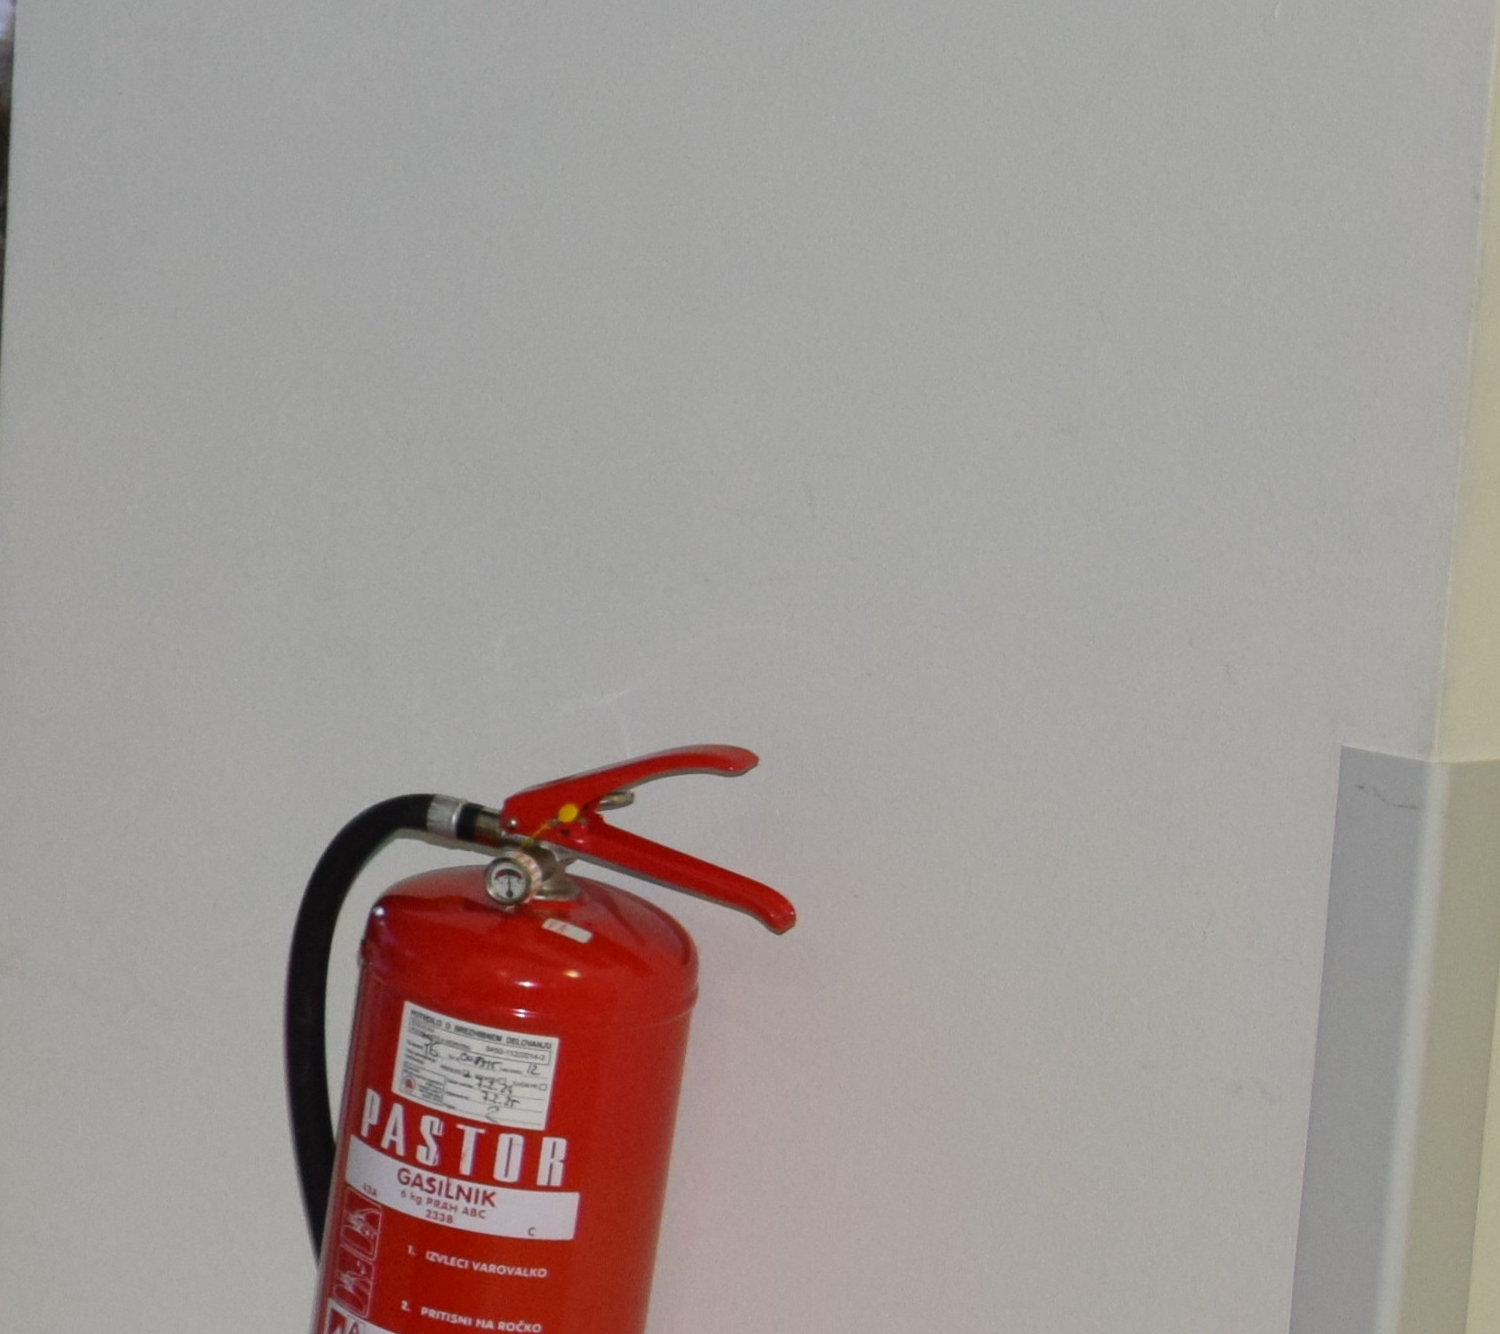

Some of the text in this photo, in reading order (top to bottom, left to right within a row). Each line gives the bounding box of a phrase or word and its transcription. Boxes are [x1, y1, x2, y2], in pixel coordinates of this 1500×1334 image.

[360, 1088, 568, 1187] PASTOR
[397, 1168, 497, 1207] GASILNIK
[462, 1206, 486, 1219] ABC
[527, 1227, 536, 1236] C
[472, 1261, 548, 1278] VAROVALKO
[421, 1306, 472, 1326] PRITISNI
[475, 1319, 494, 1329] NA
[498, 1319, 543, 1333] ROČKO
